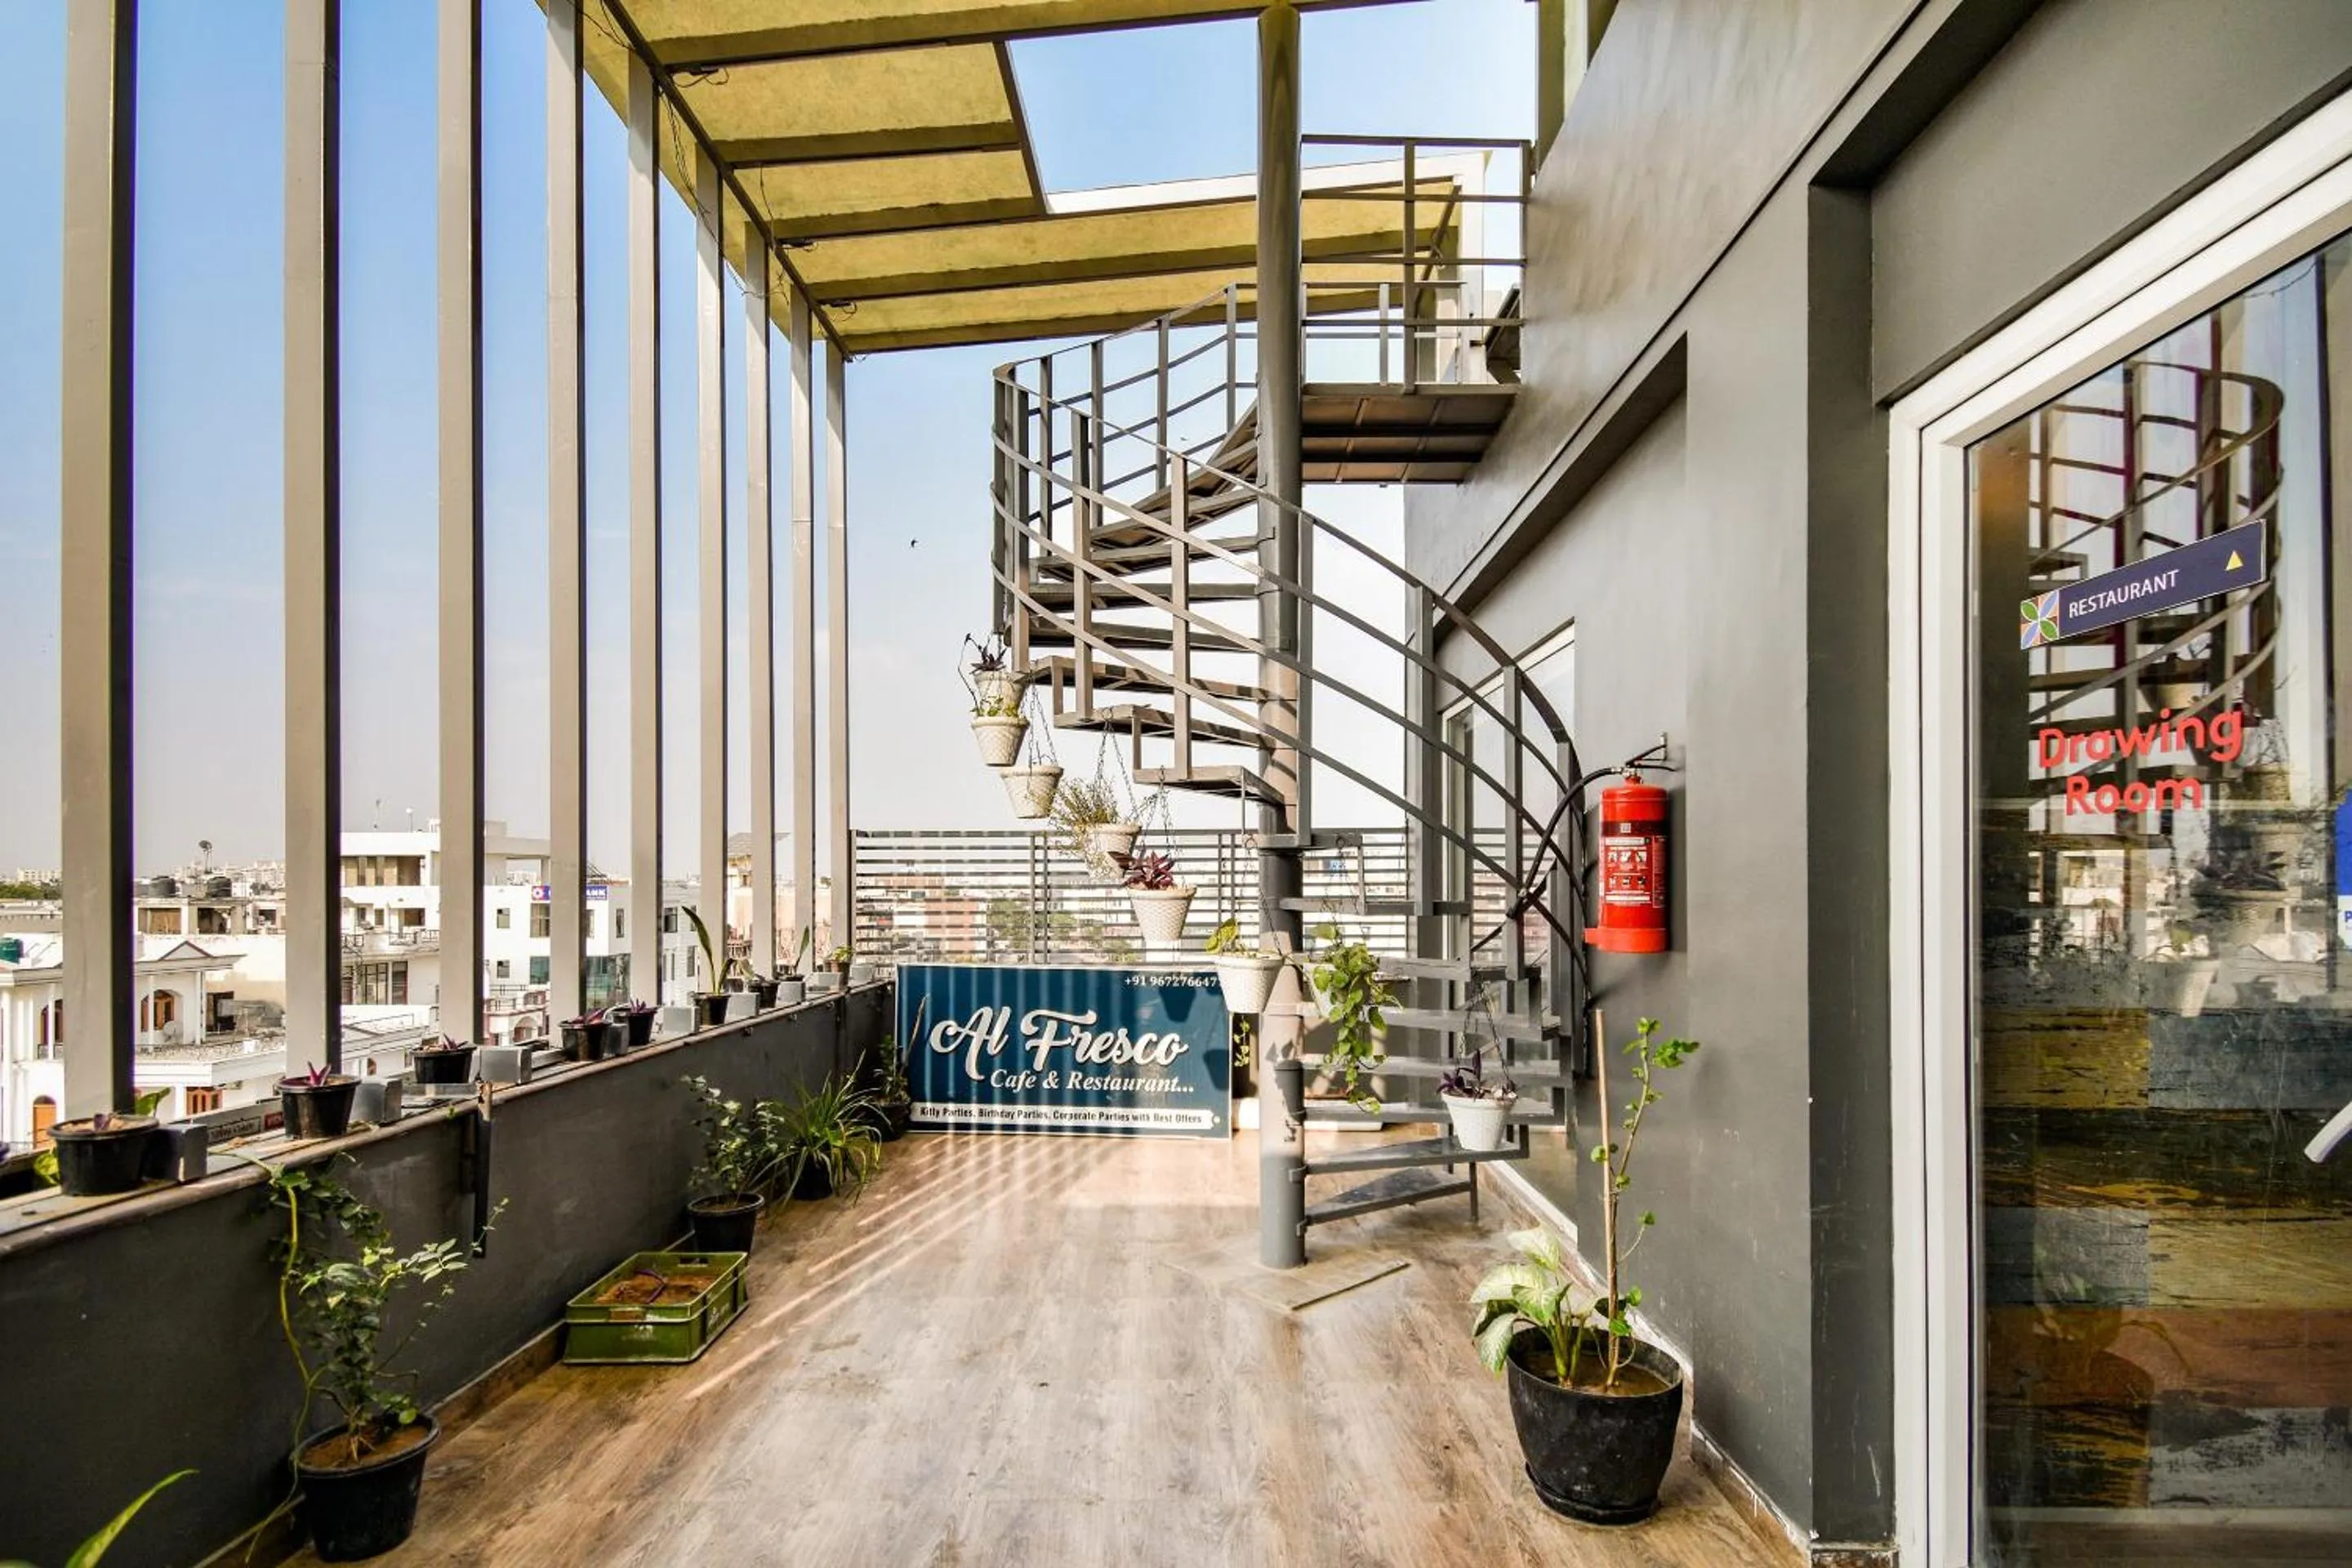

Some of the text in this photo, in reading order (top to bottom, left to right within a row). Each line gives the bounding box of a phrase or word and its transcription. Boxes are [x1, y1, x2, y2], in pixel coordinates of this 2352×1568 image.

[2069, 569, 2179, 618] RESTAURANT
[2038, 707, 2243, 768] Drawing
[2065, 775, 2203, 816] Room
[1125, 976, 1218, 987] +91 967276647
[929, 1006, 1189, 1080] Al Fresco
[990, 1068, 1036, 1093] Cafe
[1042, 1071, 1059, 1089] &
[1098, 1111, 1129, 1122] Parties
[1132, 1112, 1150, 1121] with
[1153, 1113, 1172, 1123] Best
[1175, 1113, 1202, 1124] Offers
